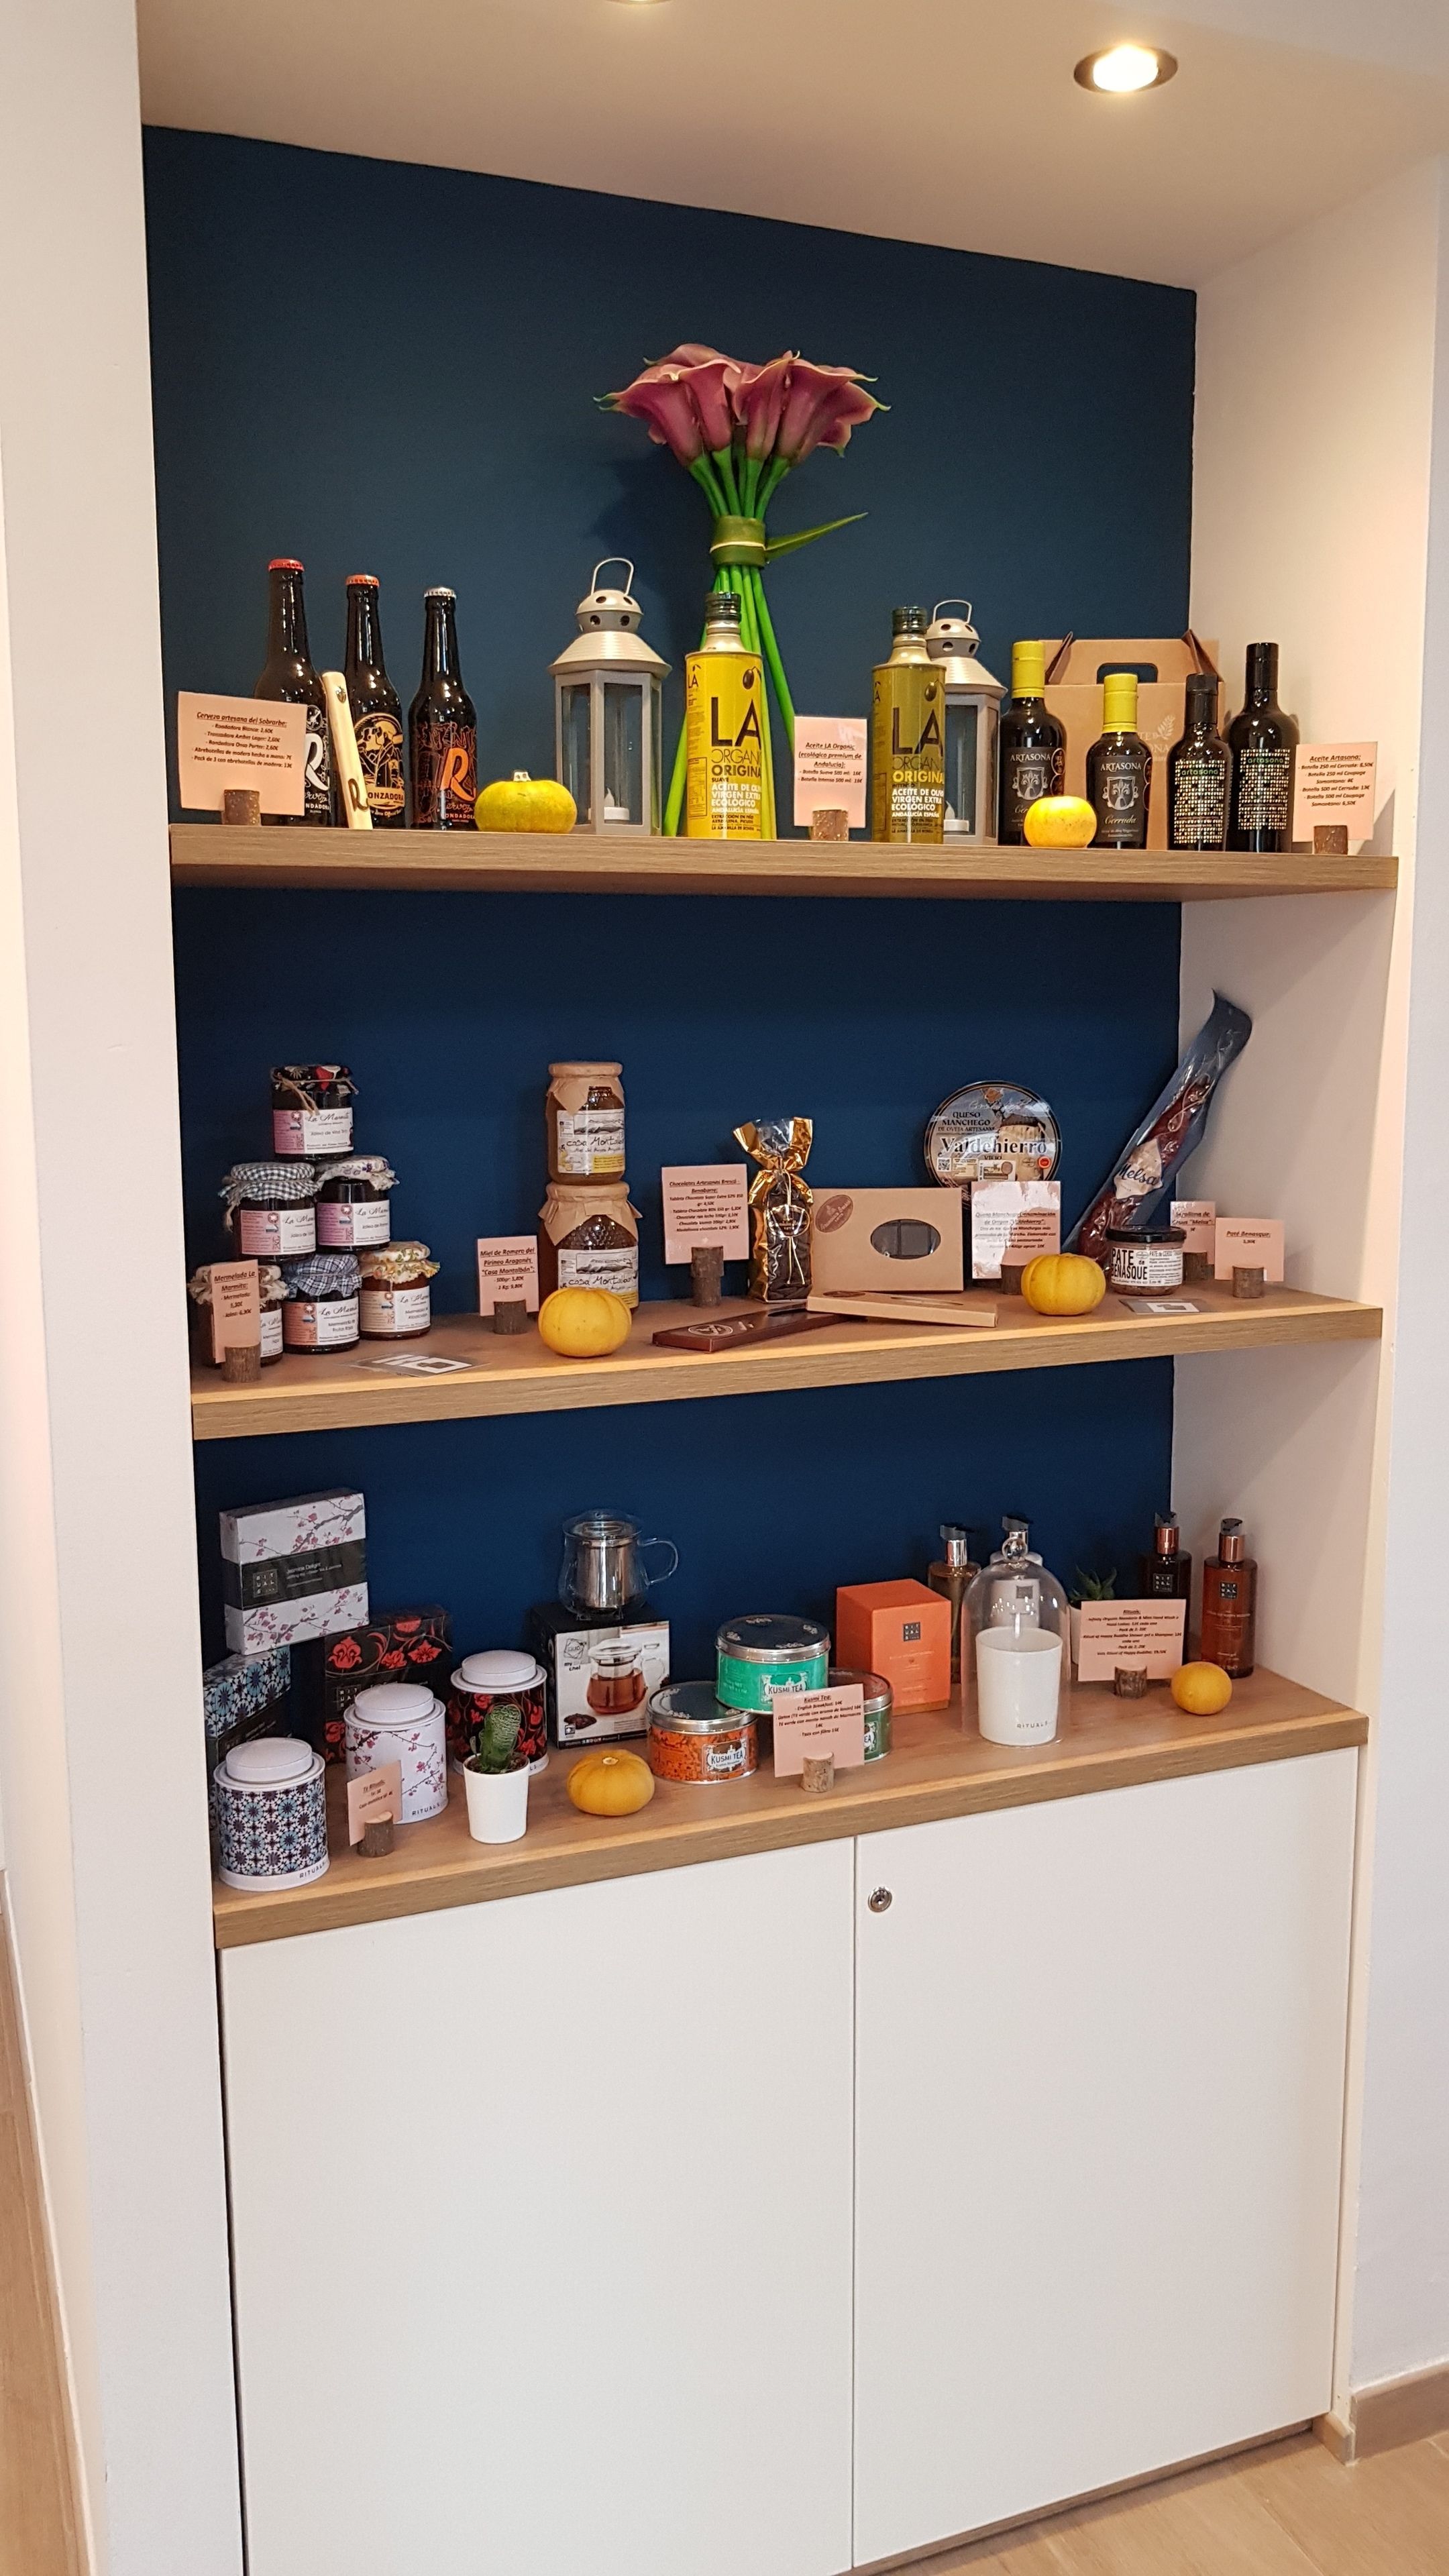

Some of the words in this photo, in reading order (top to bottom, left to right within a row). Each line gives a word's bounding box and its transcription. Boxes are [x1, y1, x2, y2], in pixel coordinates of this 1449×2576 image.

[197, 711, 220, 720] Cerveza
[221, 714, 248, 722] artesana
[712, 697, 761, 750] LA
[892, 708, 944, 757] LA
[1010, 753, 1051, 763] ARTASONA
[1100, 762, 1142, 771] ARTASONA
[1181, 767, 1219, 776] artasona
[439, 747, 476, 802] R
[712, 783, 739, 791] ACEITE
[953, 1111, 981, 1119] QUESO
[937, 1136, 1047, 1157] Valdehierro
[1118, 1163, 1159, 1186] Melsa
[1112, 1248, 1134, 1266] PATE
[767, 1686, 790, 1695] KUSMI
[792, 1684, 803, 1693] TEA
[711, 1754, 732, 1765] KUSMI
[733, 1750, 743, 1760] TEA
